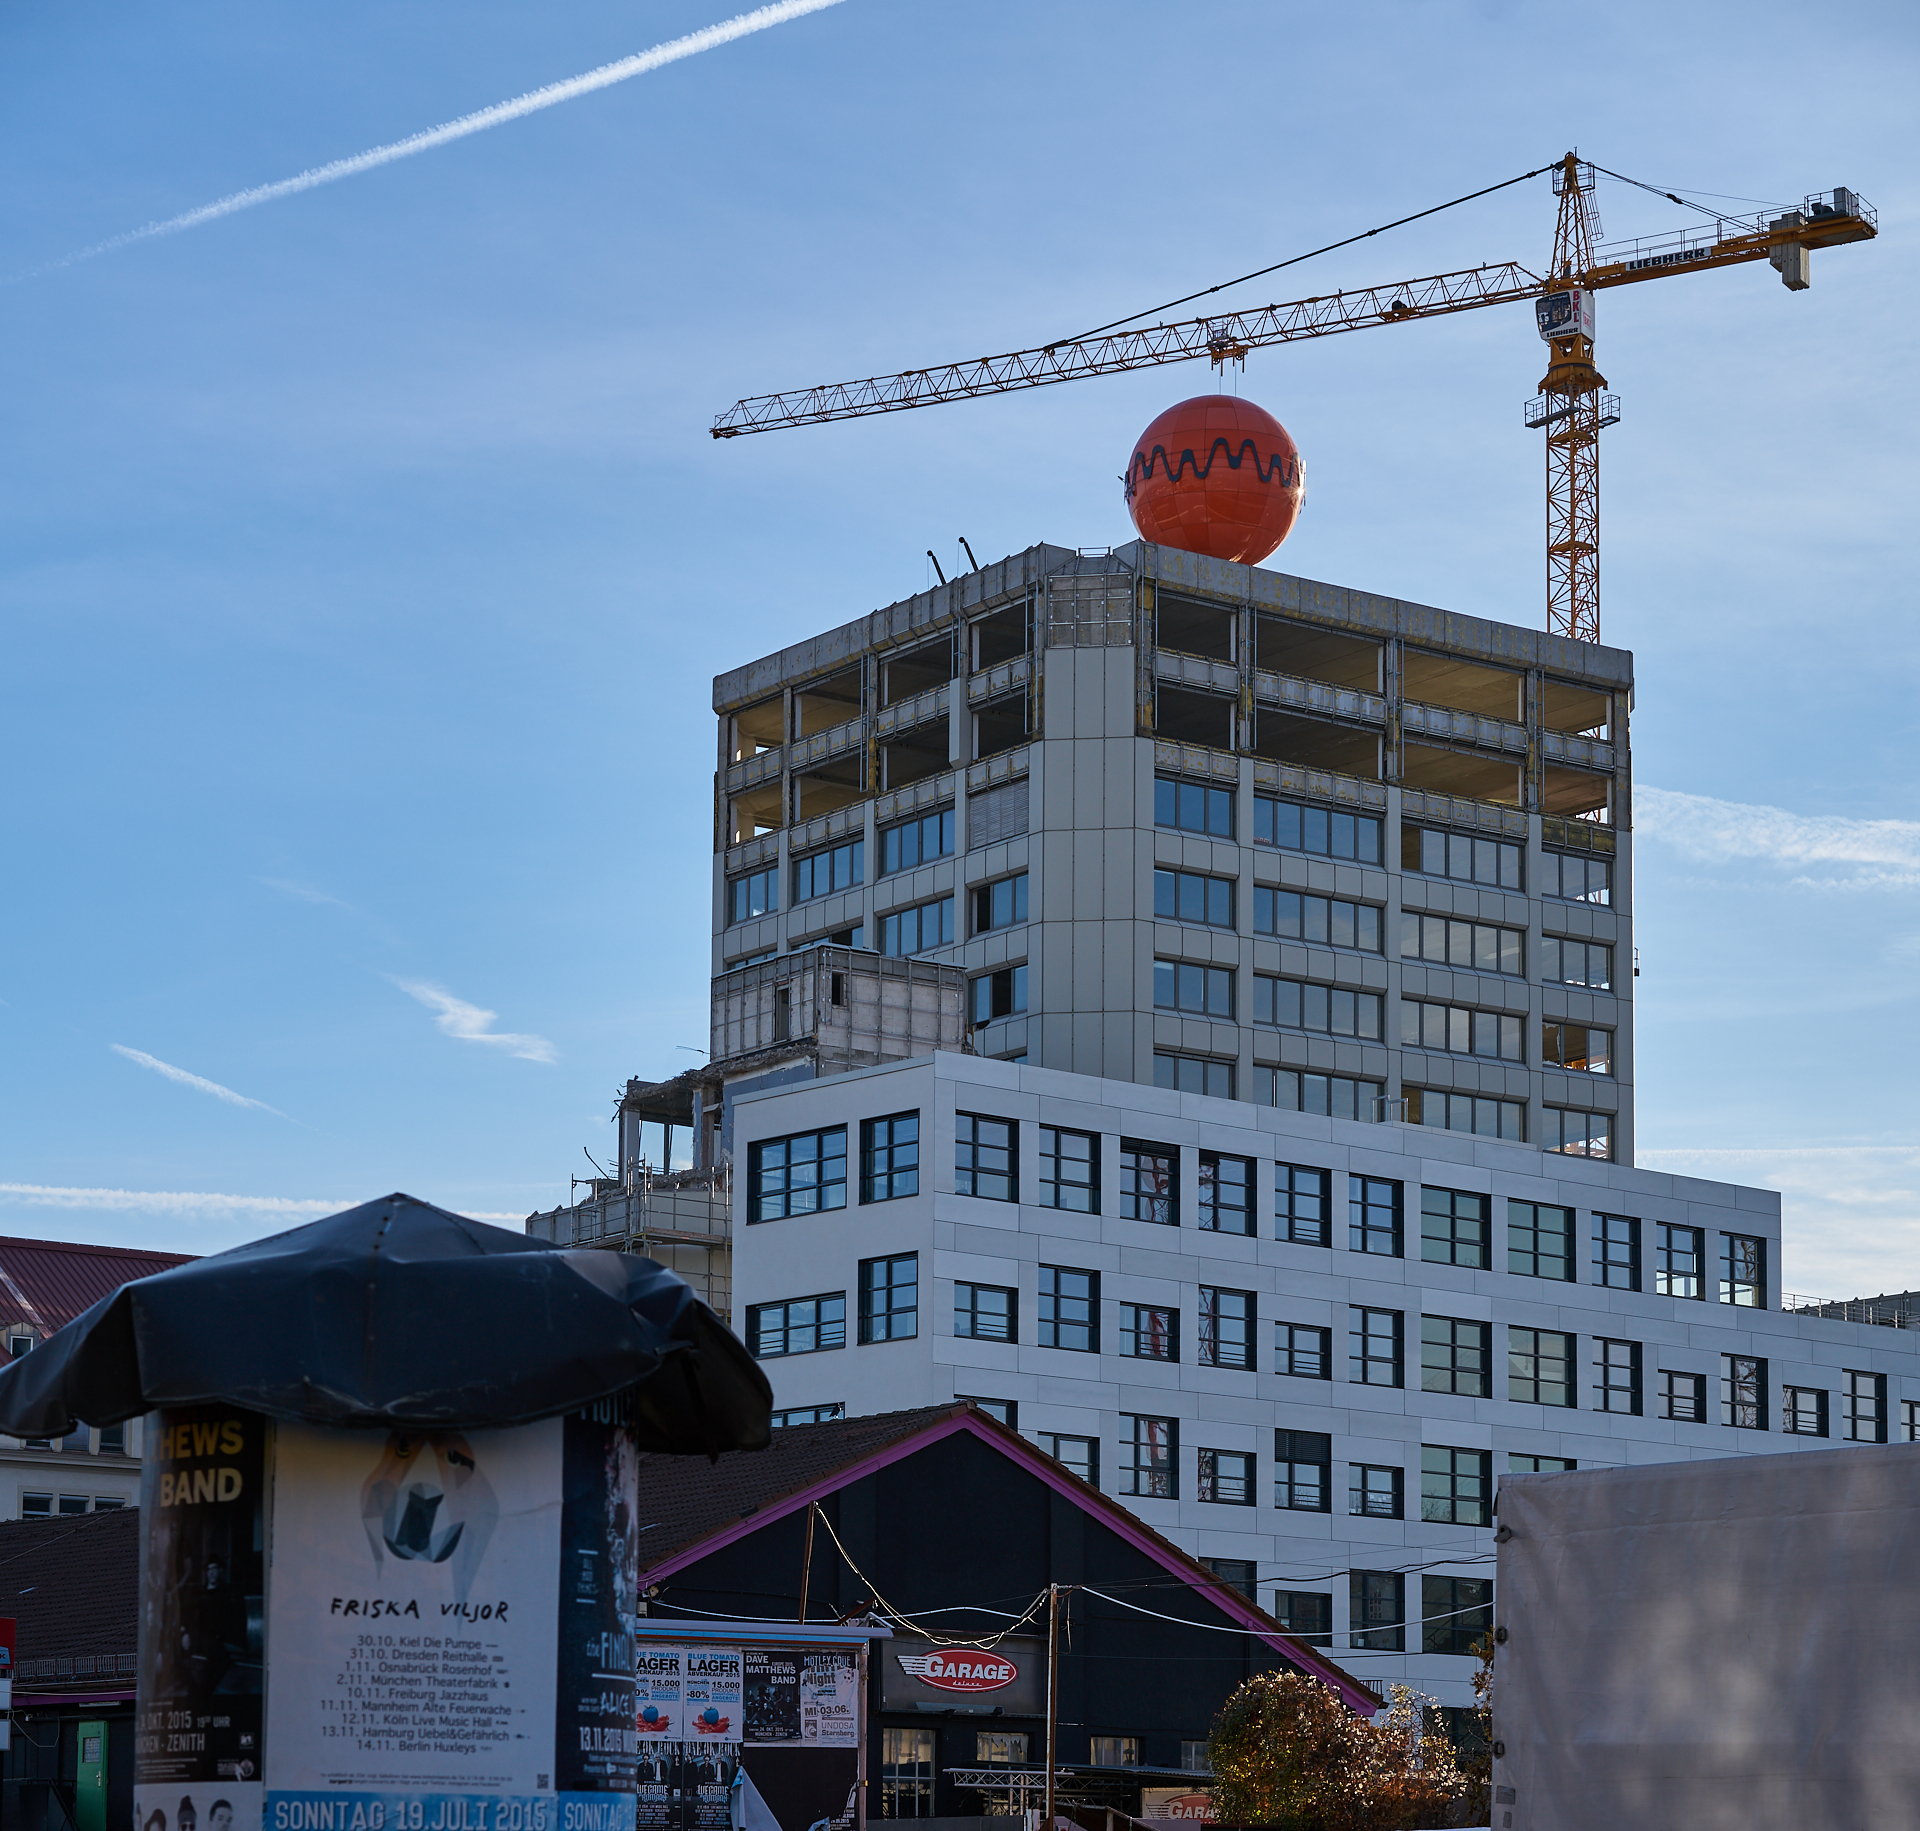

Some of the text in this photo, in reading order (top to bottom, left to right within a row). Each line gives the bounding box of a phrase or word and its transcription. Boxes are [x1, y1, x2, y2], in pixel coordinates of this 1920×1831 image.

[1629, 248, 1705, 270] LIEBHERR
[1572, 290, 1580, 323] BKL
[1546, 327, 1579, 338] LIEBHERR
[153, 1420, 244, 1462] HEWS
[160, 1467, 244, 1507] BAND
[331, 1598, 508, 1623] FRISKA VILJOR
[357, 1636, 482, 1651] 30.10. Kiel Die Pumpe
[350, 1649, 488, 1662] 31.10. Dresden Reithalle
[746, 1655, 769, 1664] DAVE
[345, 1661, 493, 1675] 1.11. Osnabrück Rosenhof
[636, 1658, 679, 1670] AGER
[687, 1659, 740, 1673] LAGER
[746, 1665, 797, 1674] MATTHEWS
[925, 1656, 1011, 1680] GARAGE
[336, 1674, 498, 1688] 2.11. München Theaterfabrik
[711, 1681, 740, 1689] 15.000
[771, 1676, 797, 1685] BAND
[807, 1673, 836, 1687] Night
[348, 1687, 489, 1702] 10.11. Freiburg Jazzhaus
[321, 1700, 512, 1715] 11.11. Mannheim Alte Feuerwache
[167, 1710, 192, 1730] 2015
[342, 1713, 493, 1727] 12.11. Köln Live Music Hall
[821, 1722, 854, 1731] UNDOSA
[322, 1726, 510, 1741] 13.11. Hamburg Uebel&Gefährlich
[821, 1730, 855, 1738] Starnberg
[166, 1732, 206, 1752] ZENITH
[357, 1739, 477, 1755] 14.11. Berlin Huxleys
[275, 1800, 386, 1831] SONNTAG
[495, 1800, 547, 1831] 2015
[565, 1802, 624, 1831] SONNTAG
